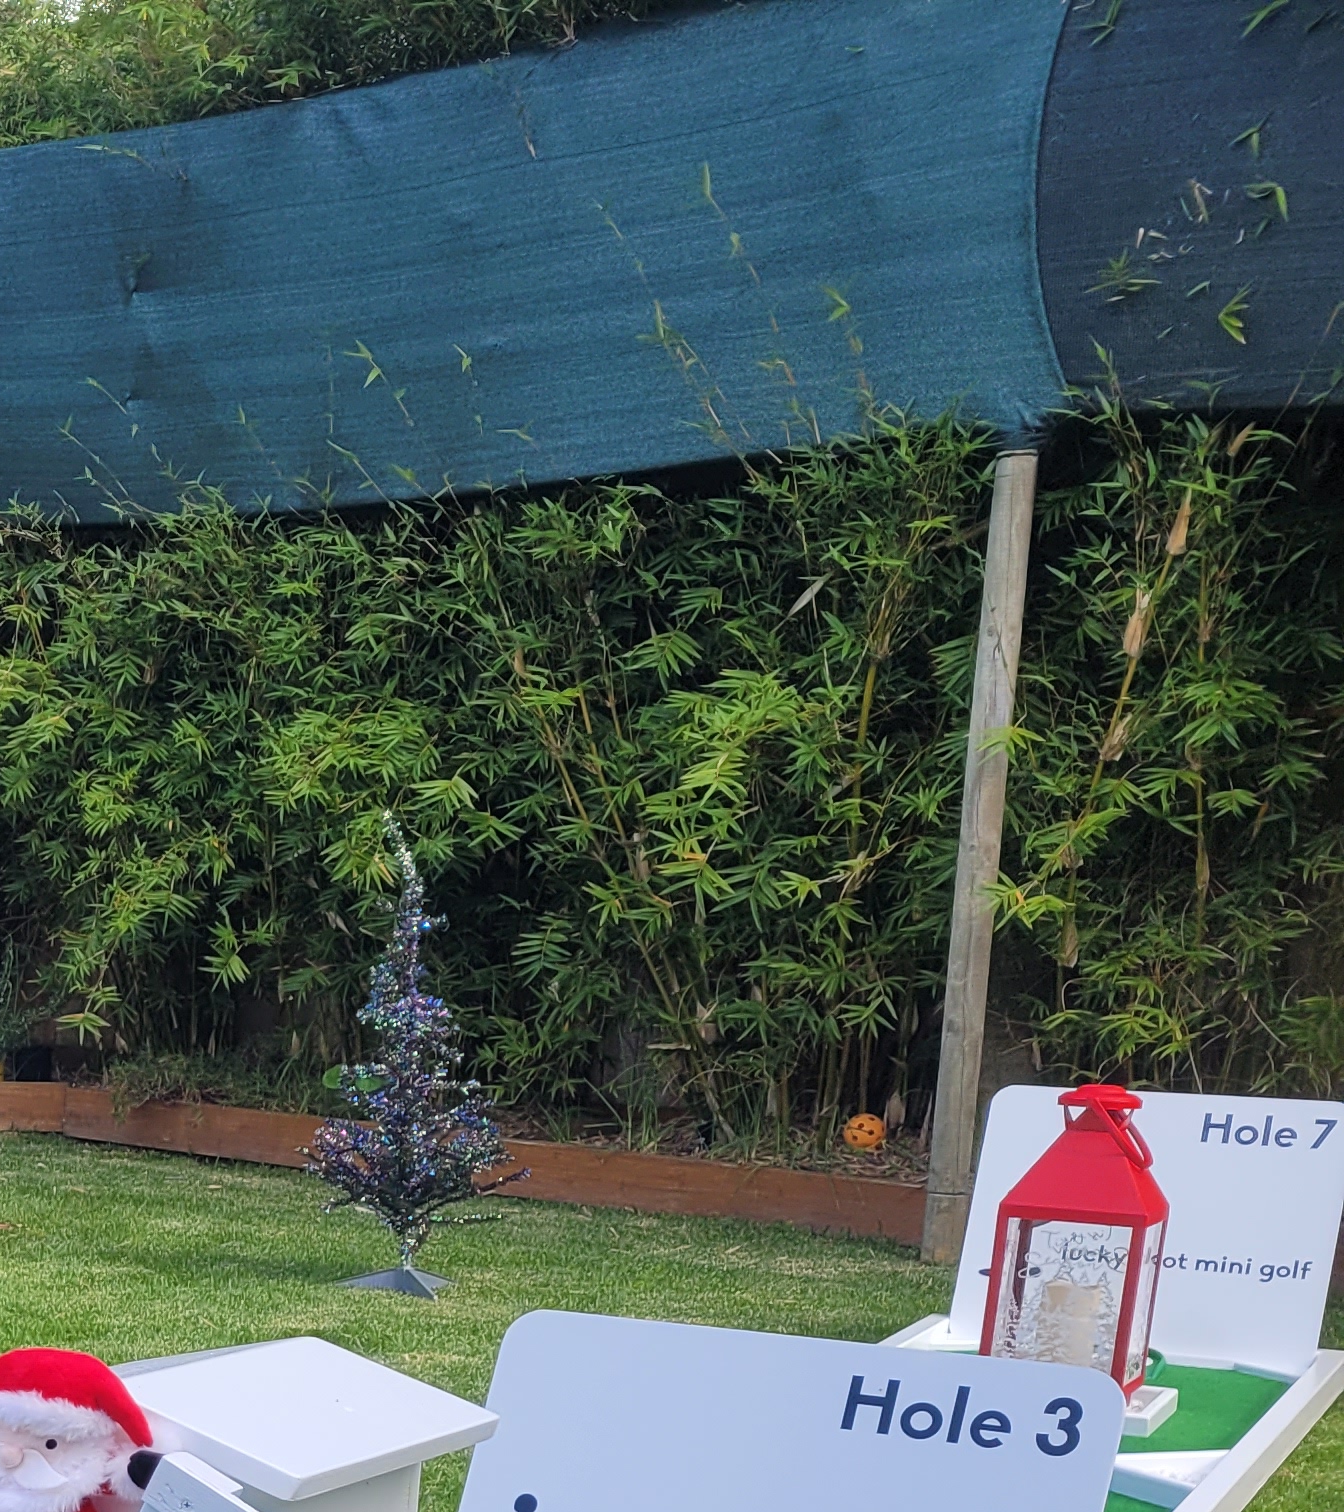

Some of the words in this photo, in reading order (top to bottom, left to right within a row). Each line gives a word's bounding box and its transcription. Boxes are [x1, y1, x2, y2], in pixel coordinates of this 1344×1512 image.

[1201, 1113, 1297, 1147] Hole
[1310, 1119, 1337, 1149] 7
[1061, 1243, 1128, 1271] lucky
[1195, 1256, 1252, 1274] mini
[1260, 1260, 1312, 1282] golf
[841, 1375, 1011, 1448] Hole
[1036, 1398, 1083, 1456] 3
